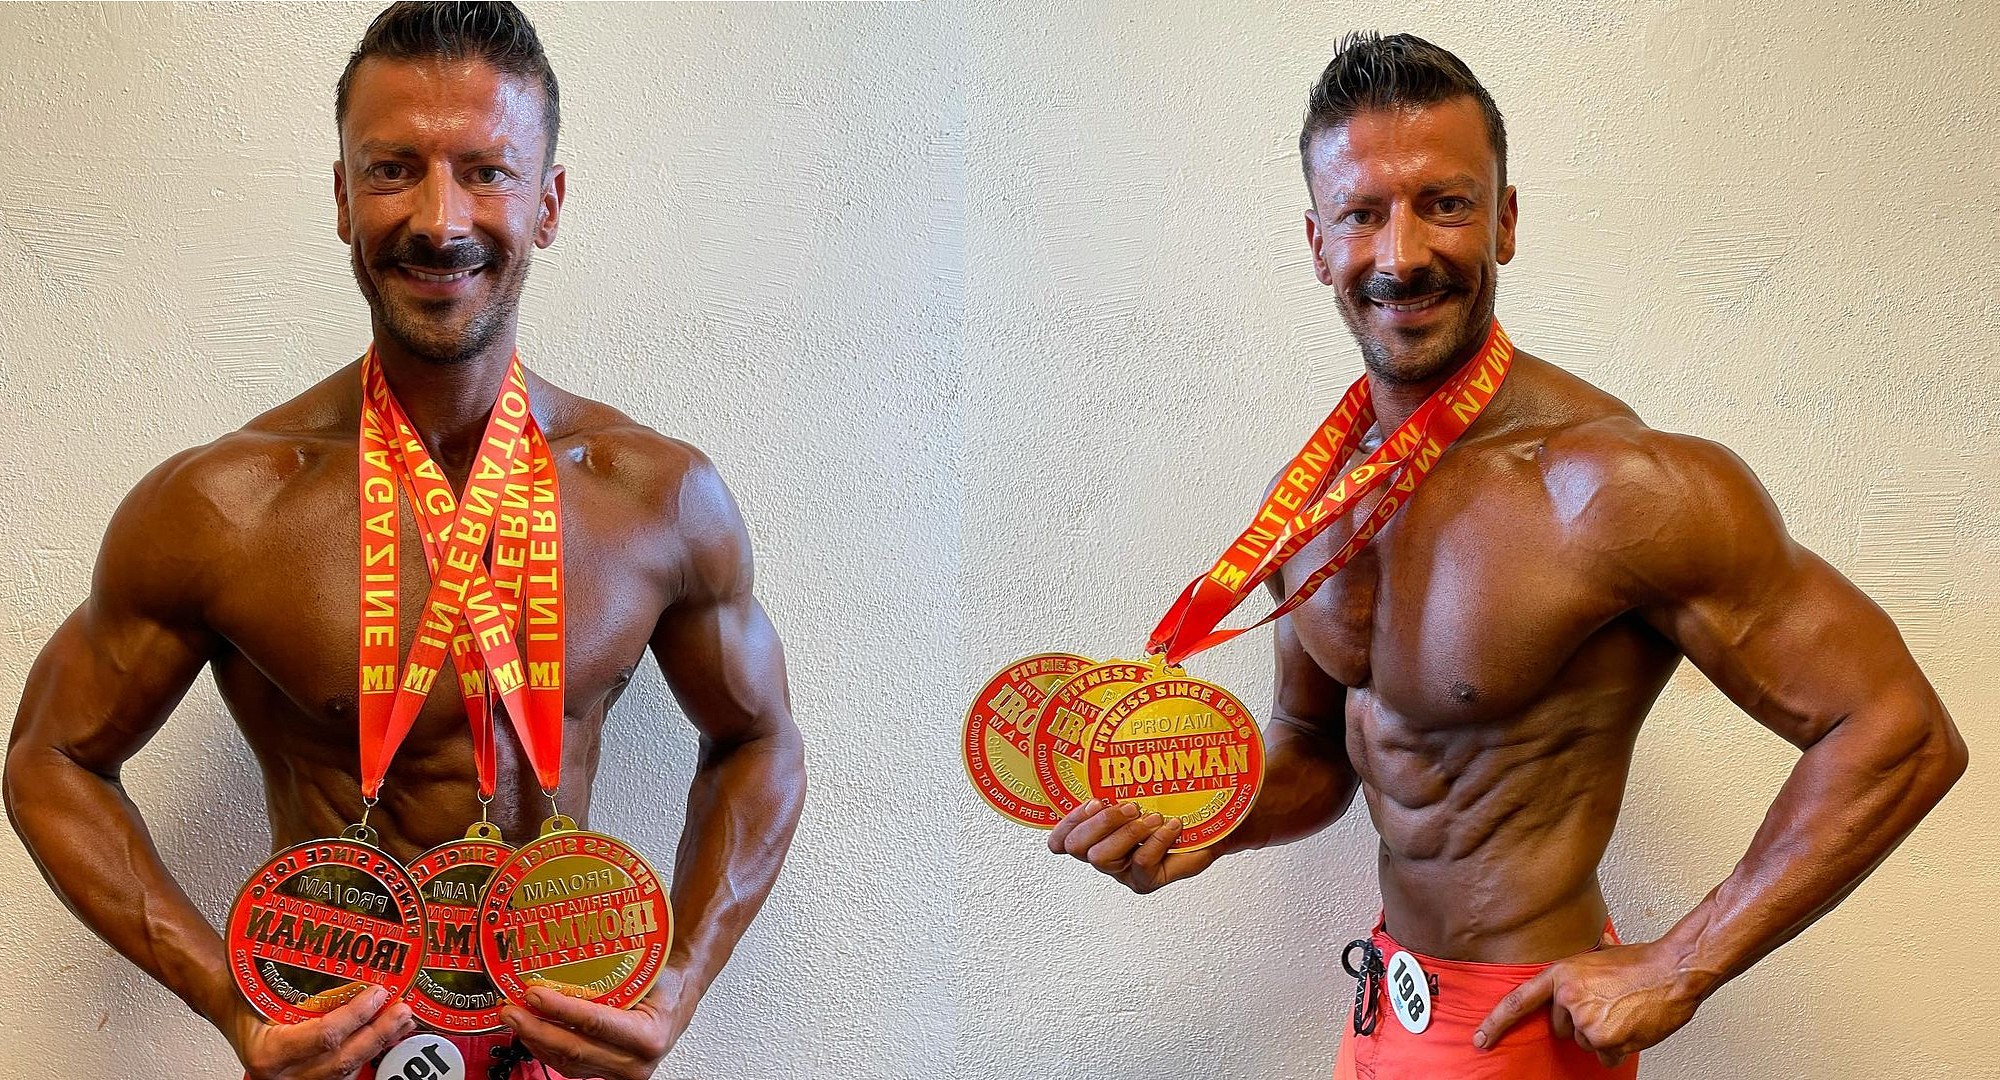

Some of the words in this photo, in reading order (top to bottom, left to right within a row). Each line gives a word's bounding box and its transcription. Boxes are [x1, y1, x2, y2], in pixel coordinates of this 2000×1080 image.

[1210, 560, 1247, 591] IM
[1010, 660, 1080, 683] FITNES
[1059, 667, 1137, 703] FITNESS
[1093, 690, 1150, 753] FITNESS
[1155, 683, 1214, 702] SINCE
[1131, 712, 1213, 735] PRO/AM
[1110, 732, 1238, 756] INTERNATIONAL
[1099, 744, 1249, 788] IRONMAN
[979, 772, 991, 787] TO
[989, 787, 1016, 811] DRUG
[1019, 806, 1046, 820] FREE
[1115, 775, 1238, 798] MAGAZINE
[1059, 796, 1073, 811] TO
[1201, 820, 1226, 837] FREE
[1225, 783, 1252, 820] SPORTS
[1394, 958, 1425, 1022] 198
